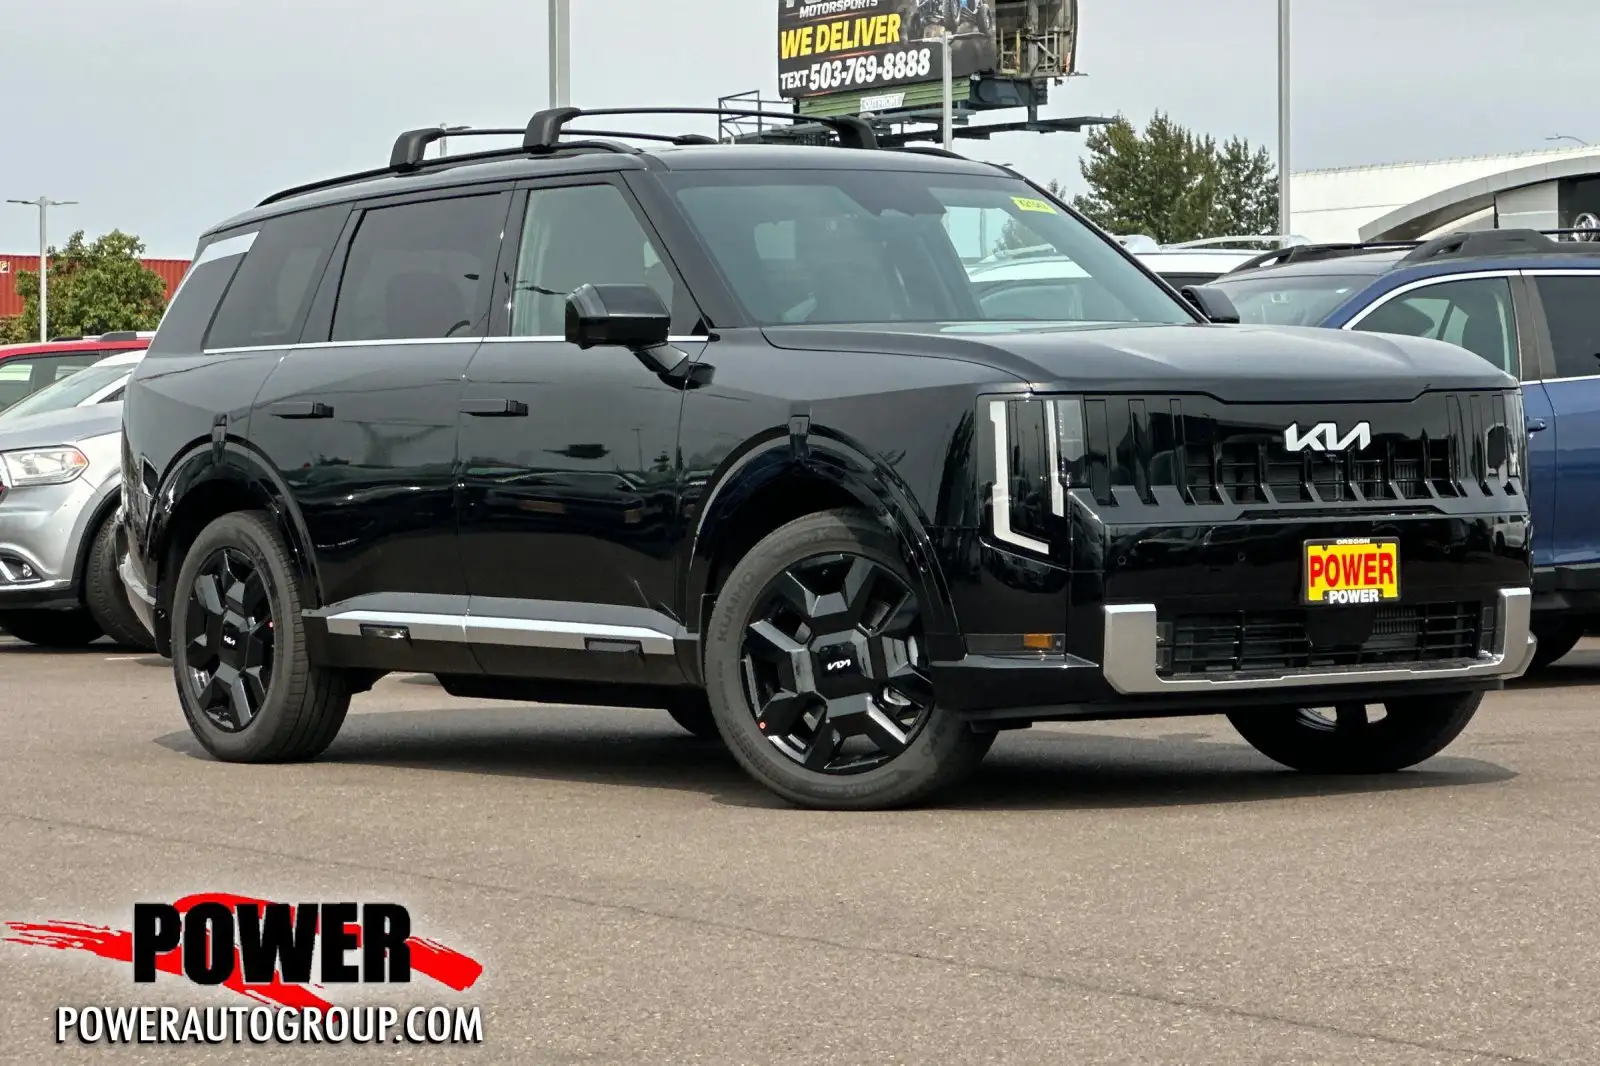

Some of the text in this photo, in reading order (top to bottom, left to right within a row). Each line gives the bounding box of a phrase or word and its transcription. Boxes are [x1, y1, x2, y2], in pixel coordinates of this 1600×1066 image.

[799, 0, 878, 18] MOTORSPORTS
[781, 14, 901, 59] WE DELIVER
[780, 48, 930, 91] TEXT 503-769-8888
[1285, 422, 1371, 451] KIA
[1310, 553, 1394, 587] POWER
[1329, 589, 1379, 604] POWER
